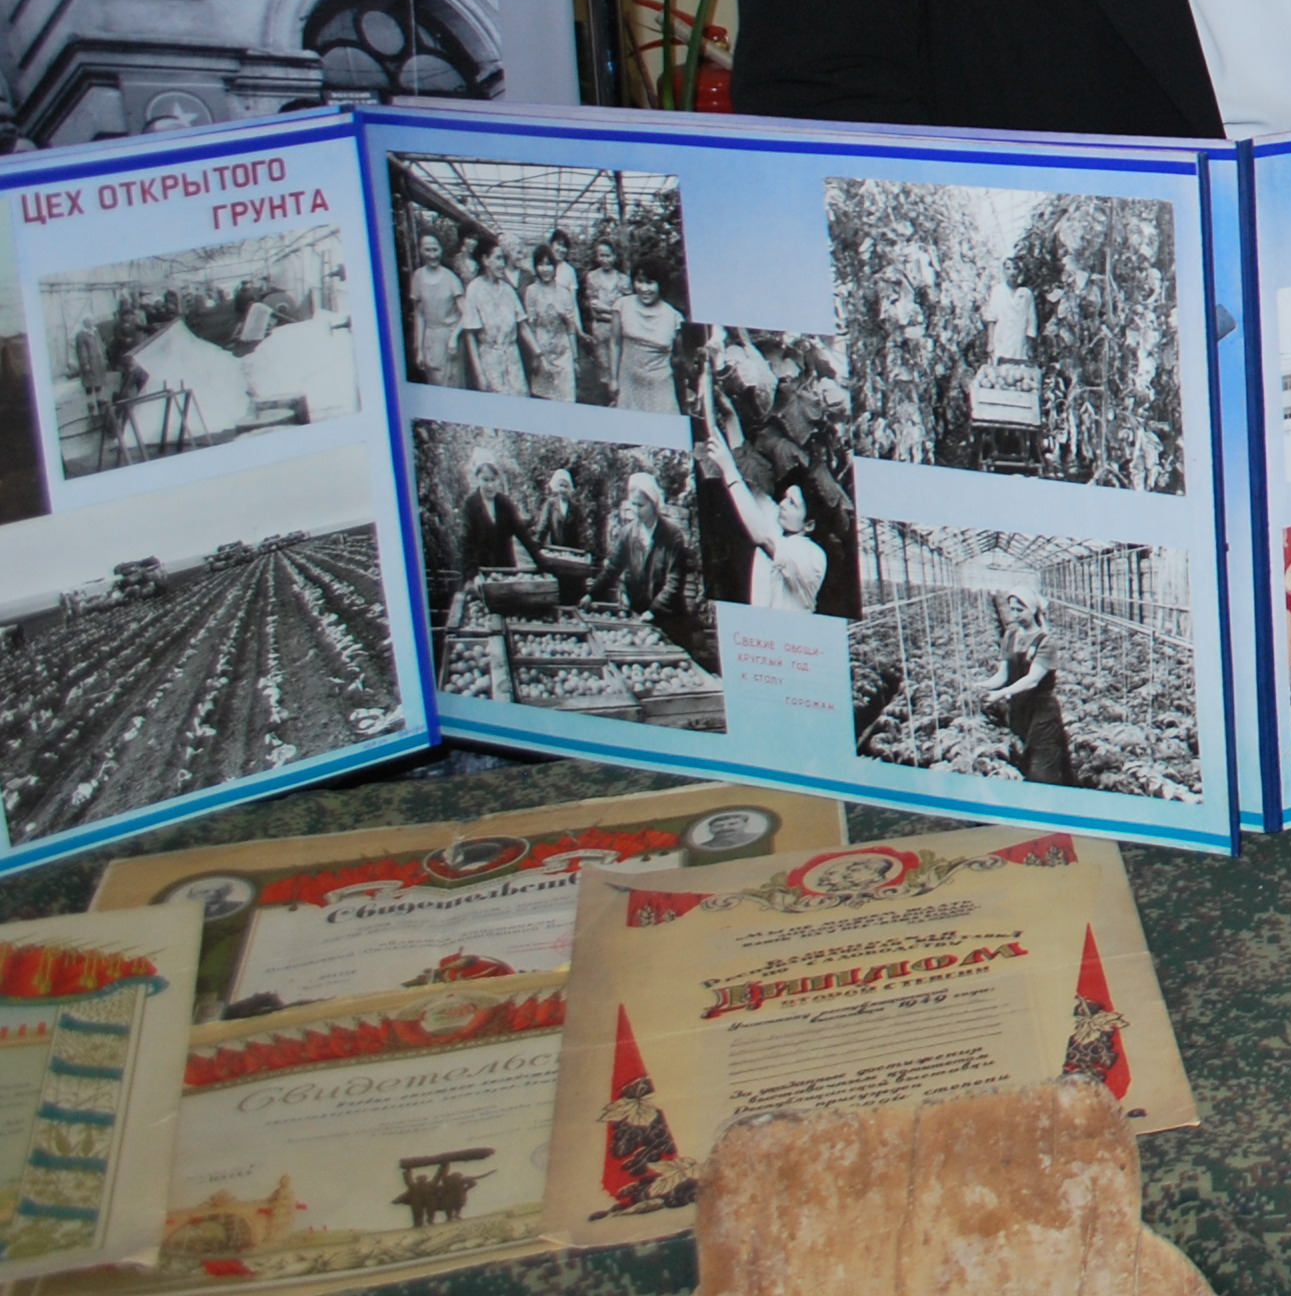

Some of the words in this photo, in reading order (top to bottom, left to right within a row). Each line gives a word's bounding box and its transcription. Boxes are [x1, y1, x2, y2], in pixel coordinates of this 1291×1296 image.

[21, 189, 85, 225] ЦЕХ
[98, 157, 287, 210] ОТКРЫТОГО
[212, 188, 330, 230] ГРУНТА
[237, 1053, 560, 1112] Свидетельс
